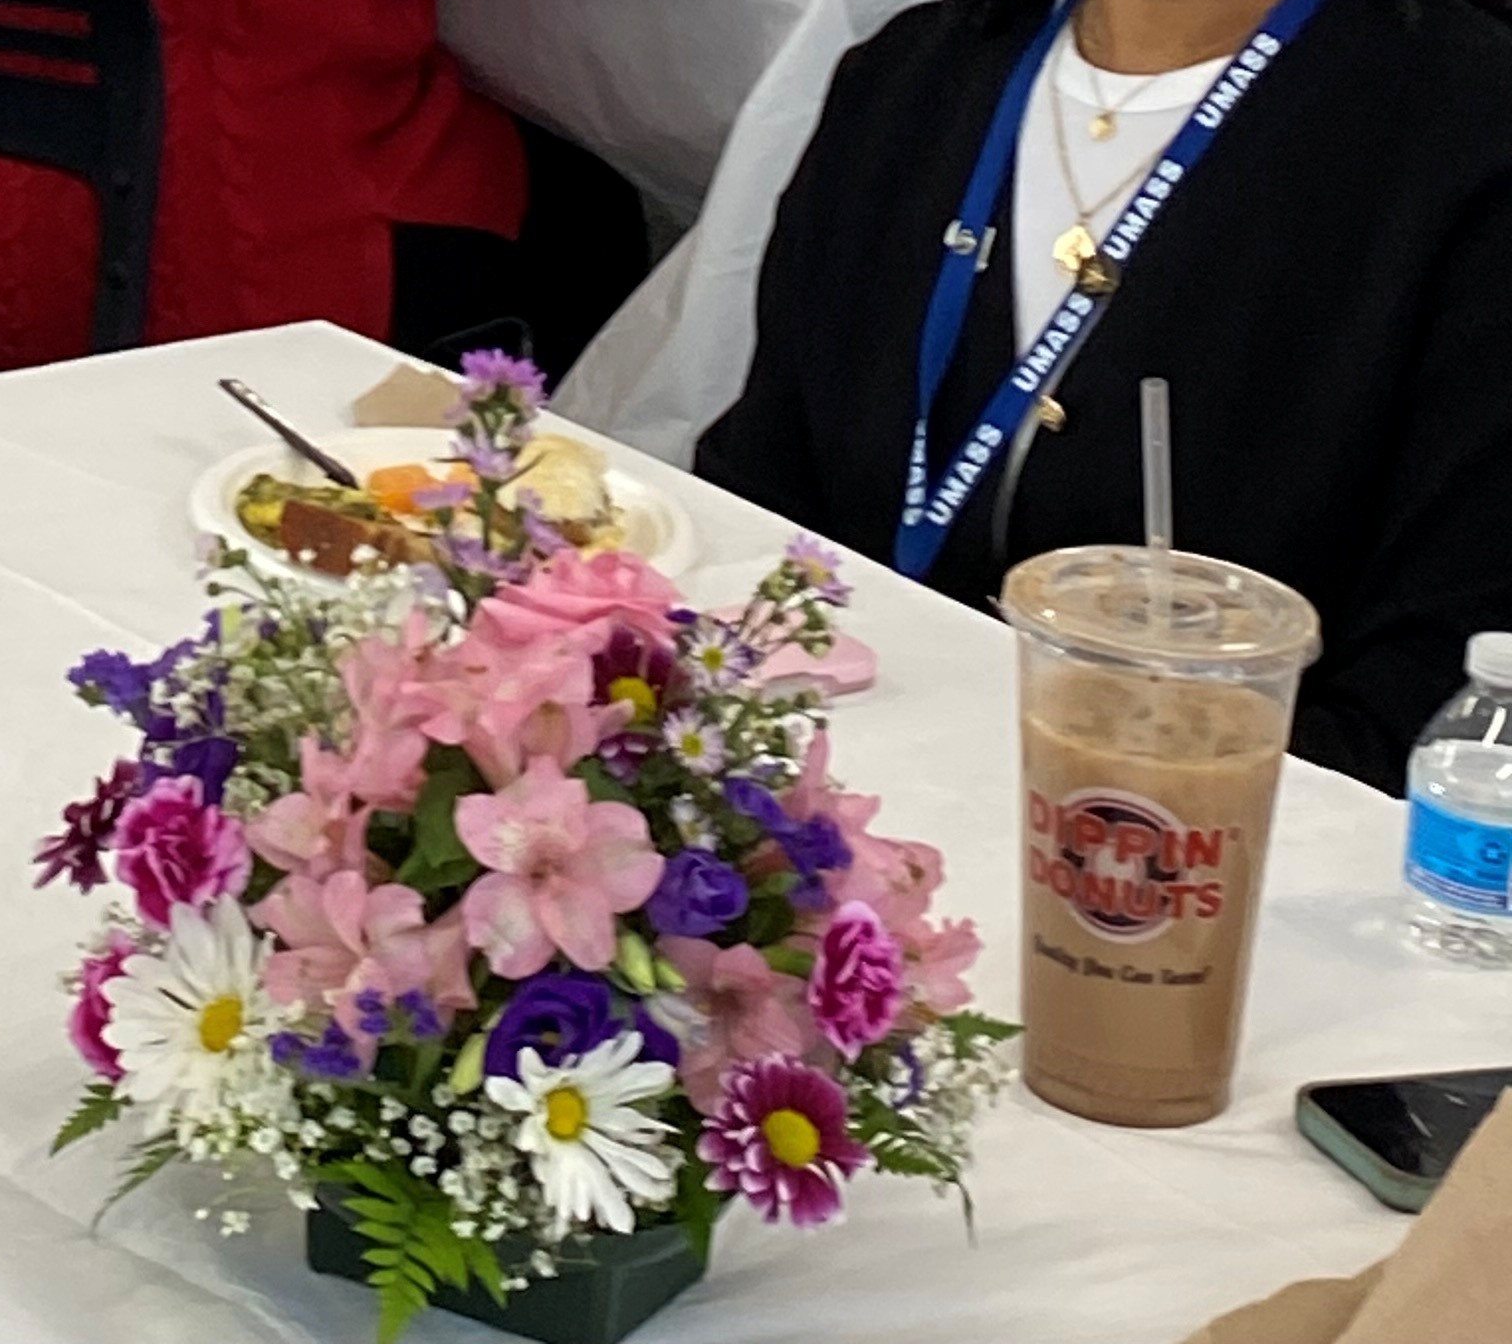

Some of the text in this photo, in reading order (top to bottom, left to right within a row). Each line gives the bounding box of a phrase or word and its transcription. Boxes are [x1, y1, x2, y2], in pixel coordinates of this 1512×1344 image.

[1194, 32, 1281, 128] UMASS
[1103, 159, 1184, 260] UMASS
[1011, 292, 1094, 392] UMASS
[926, 423, 1003, 526] UMASS
[1030, 843, 1224, 921] DONUTS
